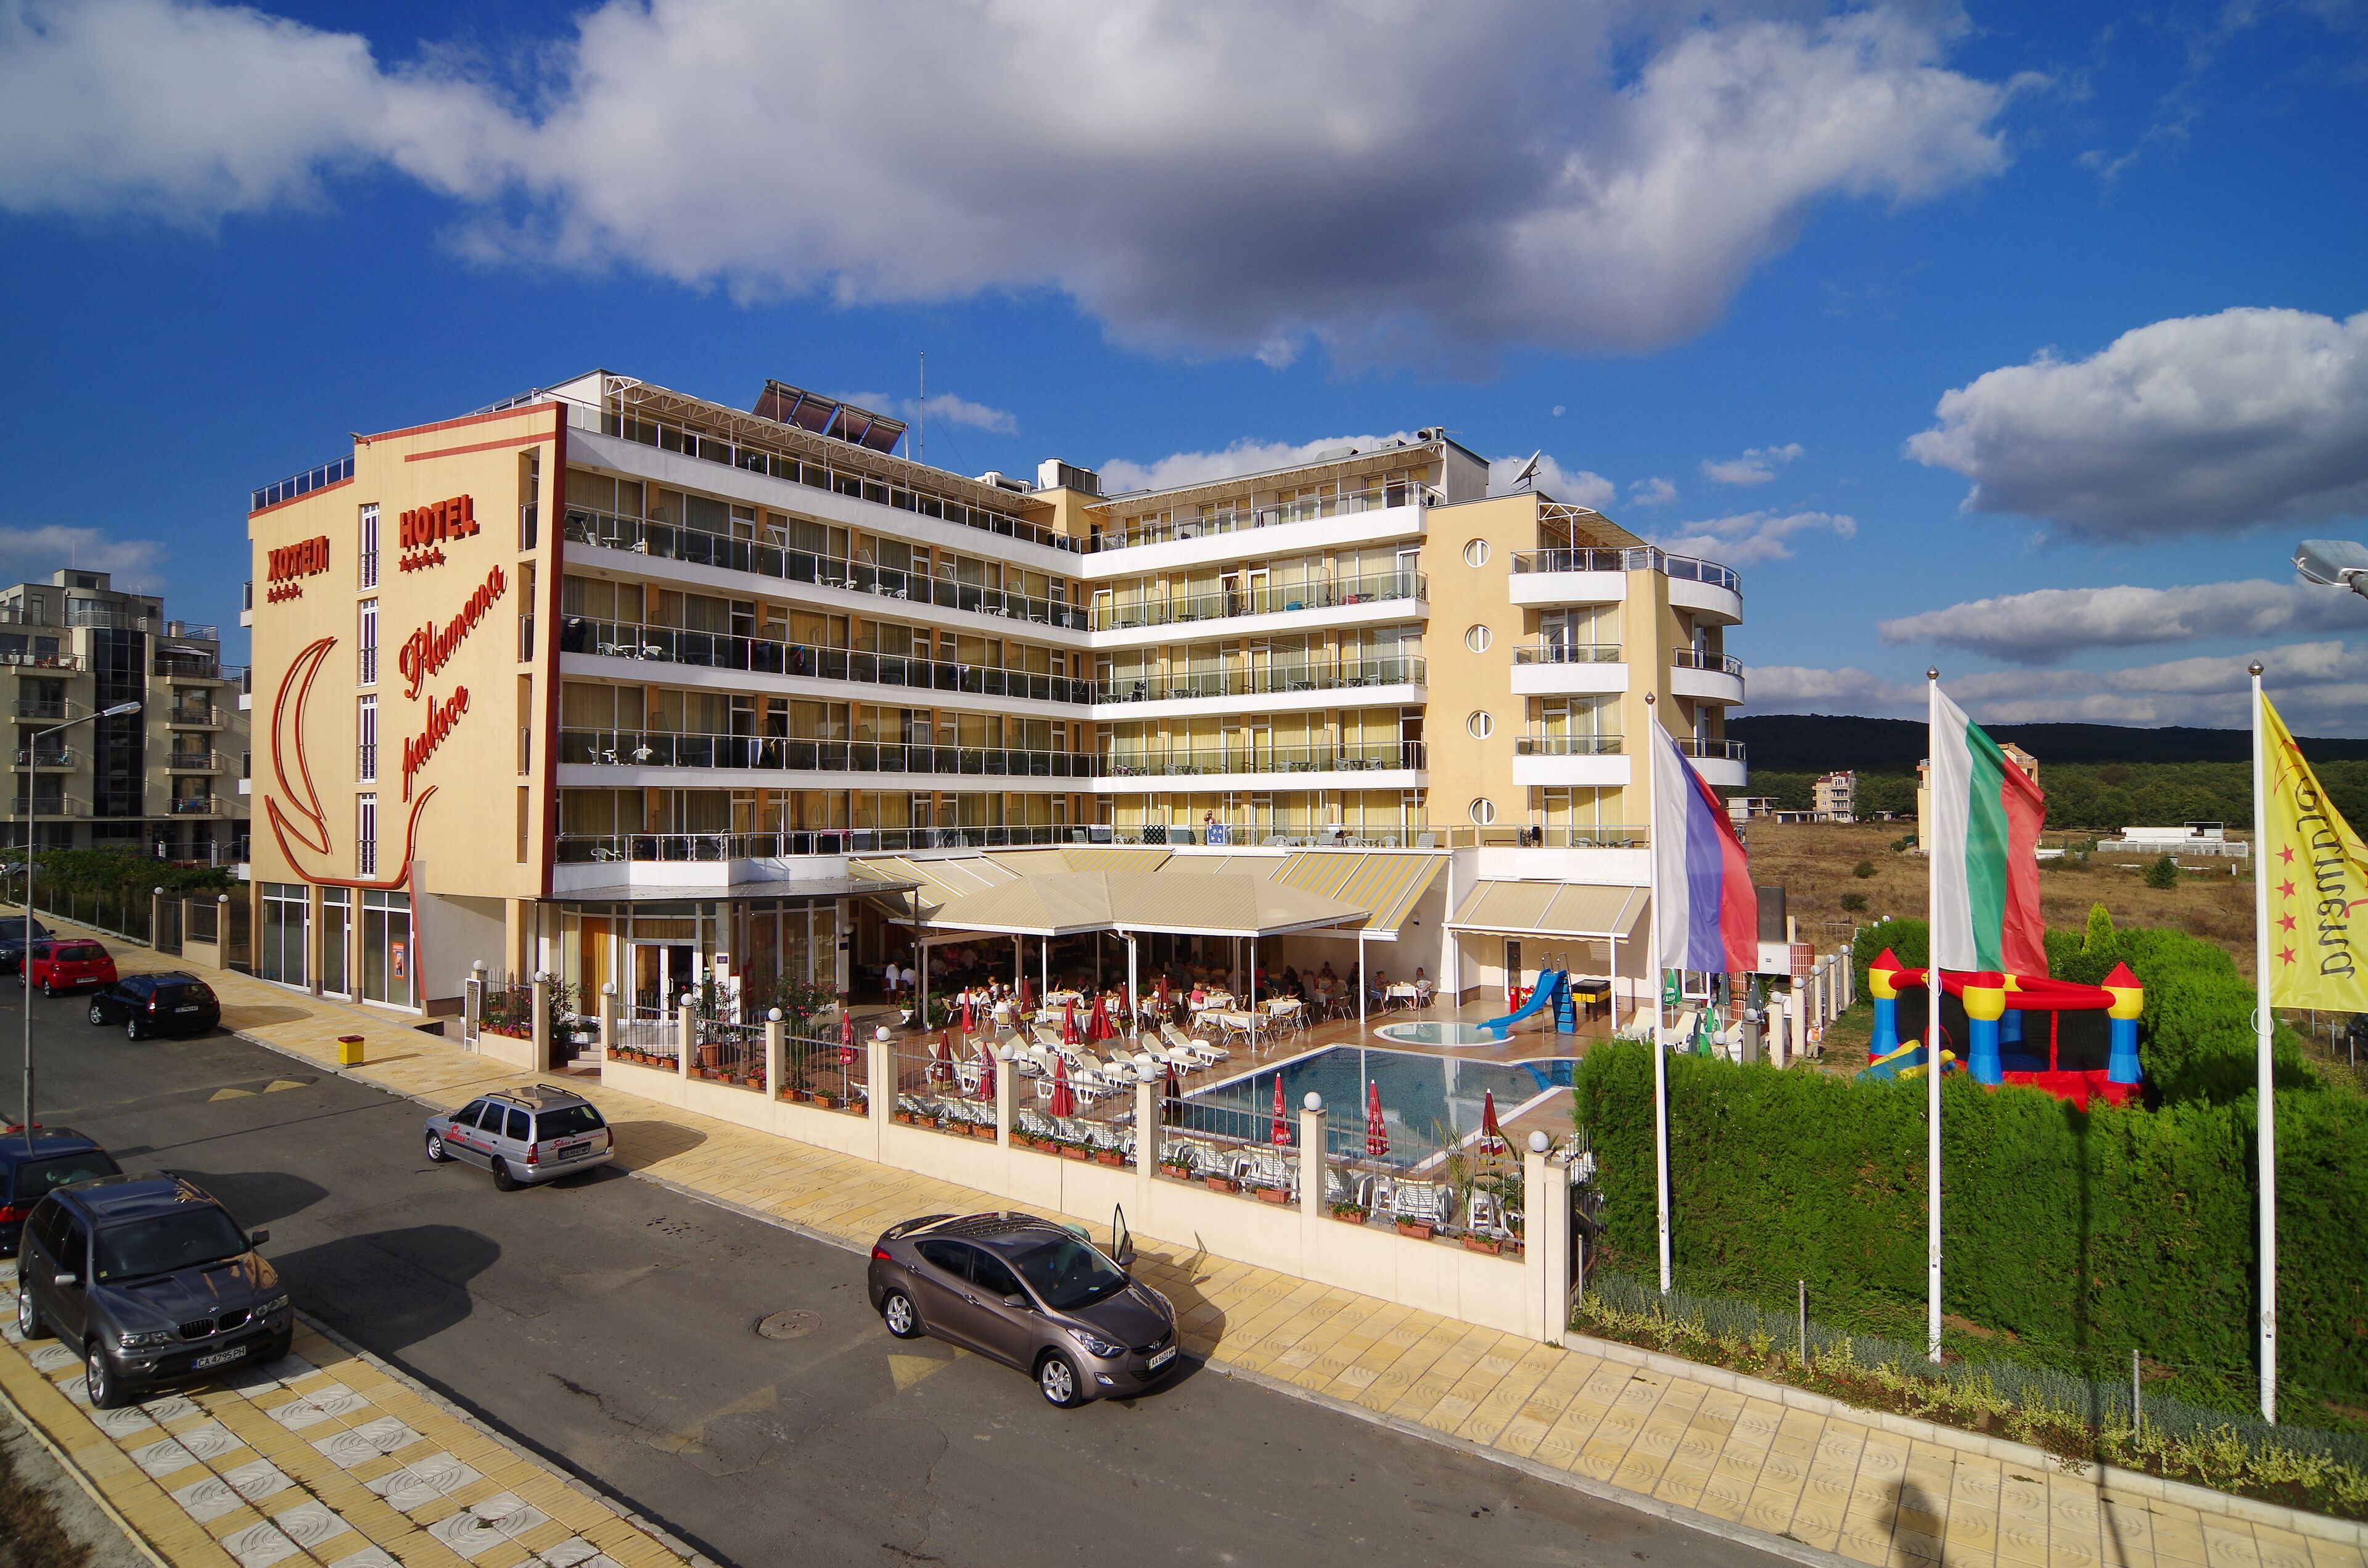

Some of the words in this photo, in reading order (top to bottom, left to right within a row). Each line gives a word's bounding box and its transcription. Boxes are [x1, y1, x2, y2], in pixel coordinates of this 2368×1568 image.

[400, 494, 477, 549] HOTEL
[266, 535, 327, 582] ХОТЕЛ
[398, 564, 505, 699] Plamena
[402, 685, 469, 803] palace
[550, 1139, 571, 1151] Solvex
[199, 1358, 210, 1367] CA
[212, 1351, 232, 1363] 4795
[234, 1347, 245, 1357] PH
